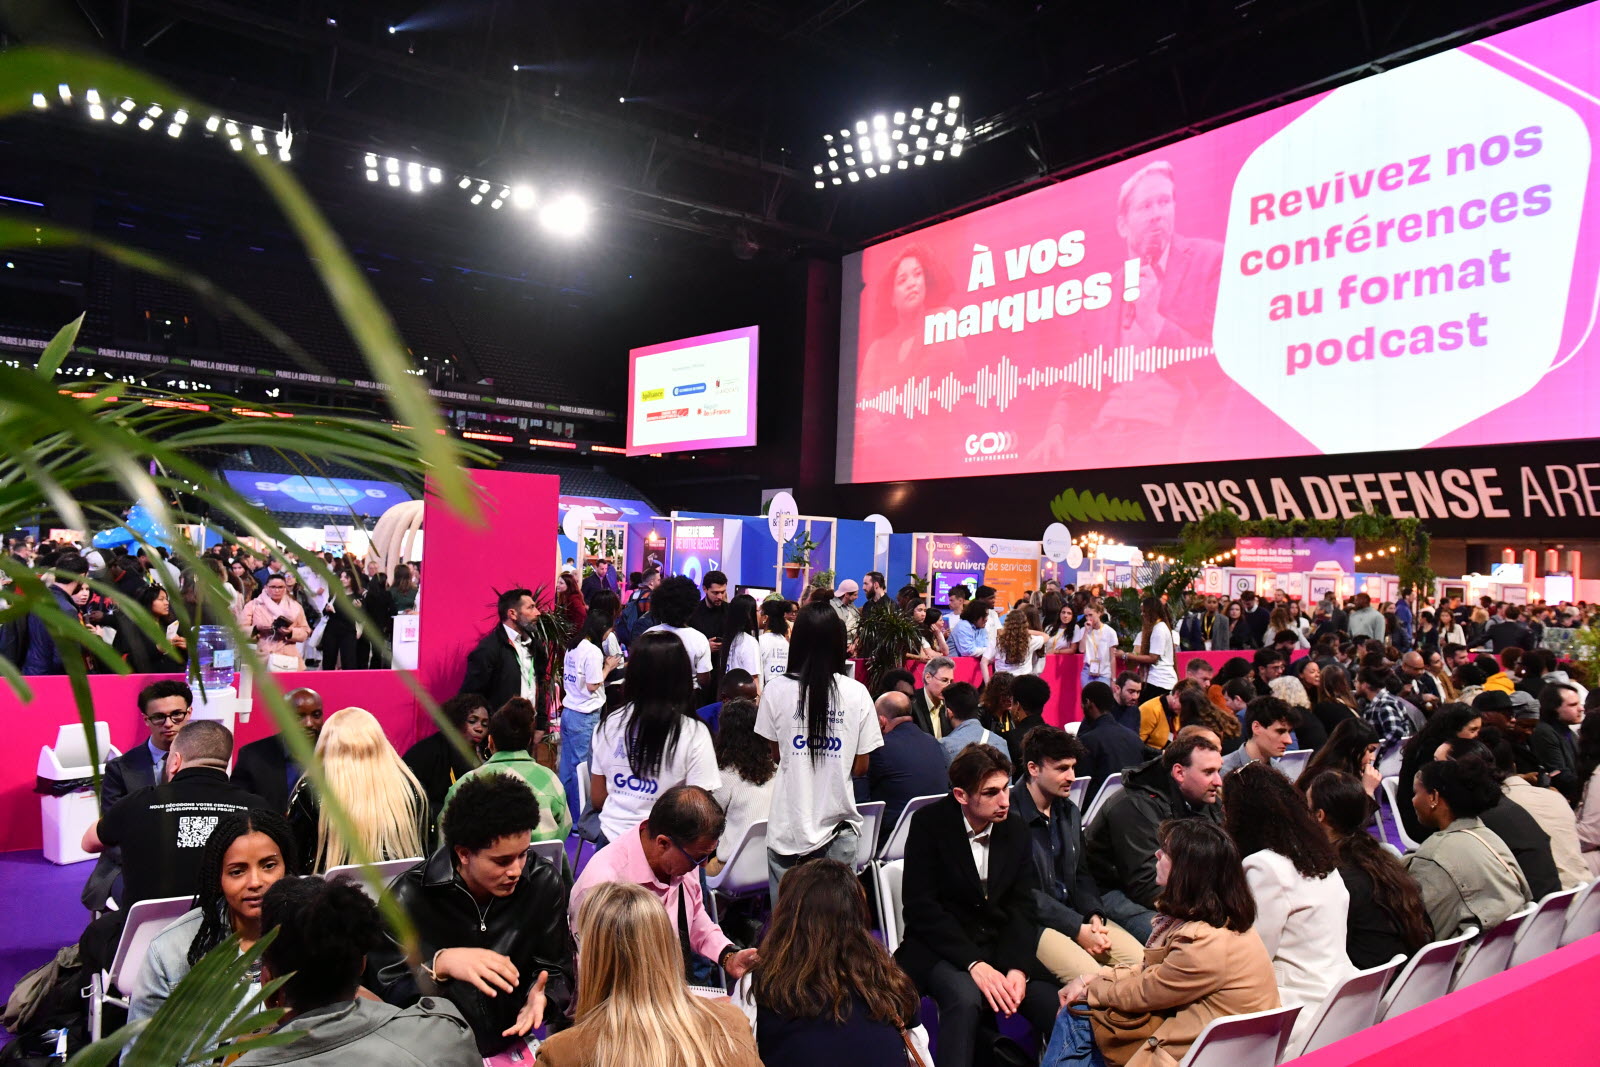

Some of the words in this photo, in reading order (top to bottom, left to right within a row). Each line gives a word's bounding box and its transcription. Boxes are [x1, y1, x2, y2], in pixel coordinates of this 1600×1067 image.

[1249, 154, 1431, 226] Revivez
[1446, 125, 1543, 176] nos
[967, 243, 996, 292] À
[1004, 229, 1085, 281] vos
[1239, 183, 1552, 277] conférences
[923, 271, 1112, 345] marques
[1268, 287, 1323, 322] au
[1338, 248, 1511, 310] format
[27, 338, 50, 349] DEFEN
[126, 351, 151, 361] DEFENSE
[216, 362, 239, 373] DEFENSE
[1286, 312, 1488, 376] podcast
[300, 373, 321, 382] DEFENSE
[1141, 478, 1250, 522] PARIS
[1247, 476, 1300, 521] LA
[1300, 467, 1510, 520] DEFENSE
[1519, 462, 1600, 519] ARE
[955, 559, 985, 571] univers
[987, 561, 998, 571] de
[1000, 562, 1031, 572] services
